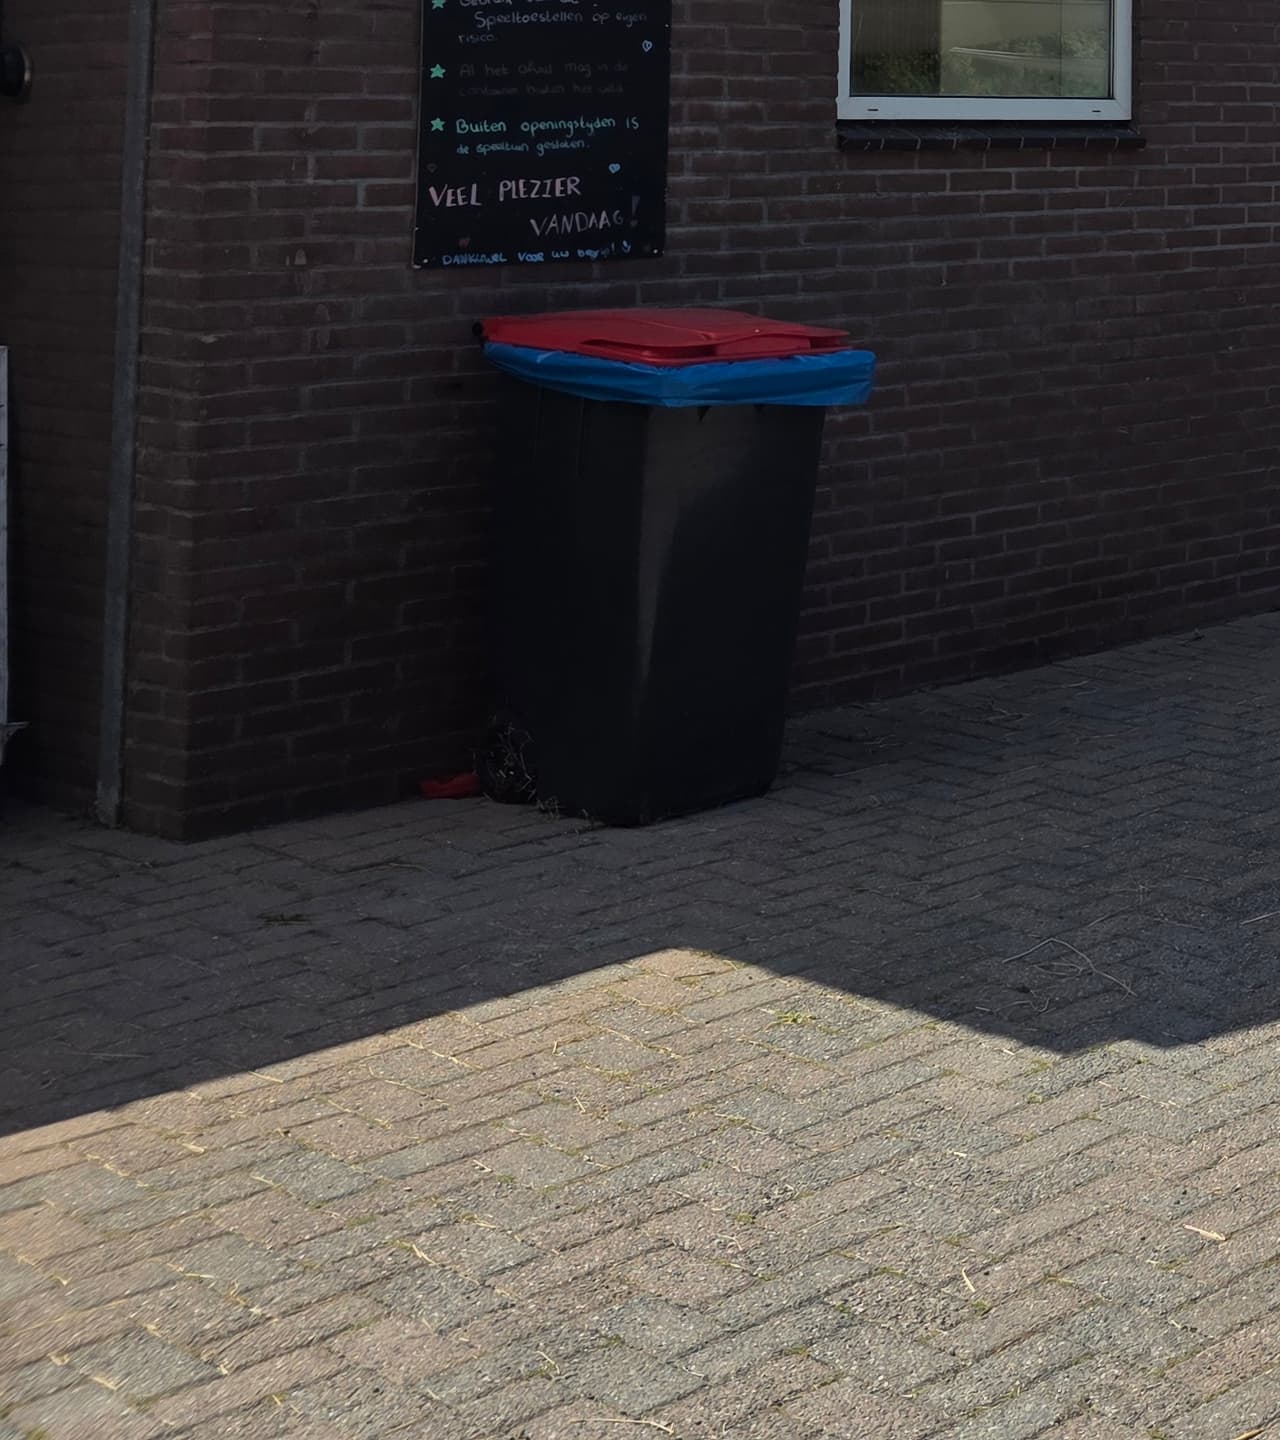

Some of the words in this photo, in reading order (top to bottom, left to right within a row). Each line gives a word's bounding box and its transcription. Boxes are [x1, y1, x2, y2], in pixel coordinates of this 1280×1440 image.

[592, 11, 609, 22] op
[616, 11, 648, 28] eigen
[456, 119, 507, 134] Buiten
[456, 142, 469, 154] de
[428, 183, 482, 207] VEEL
[498, 176, 581, 201] PLEZIER
